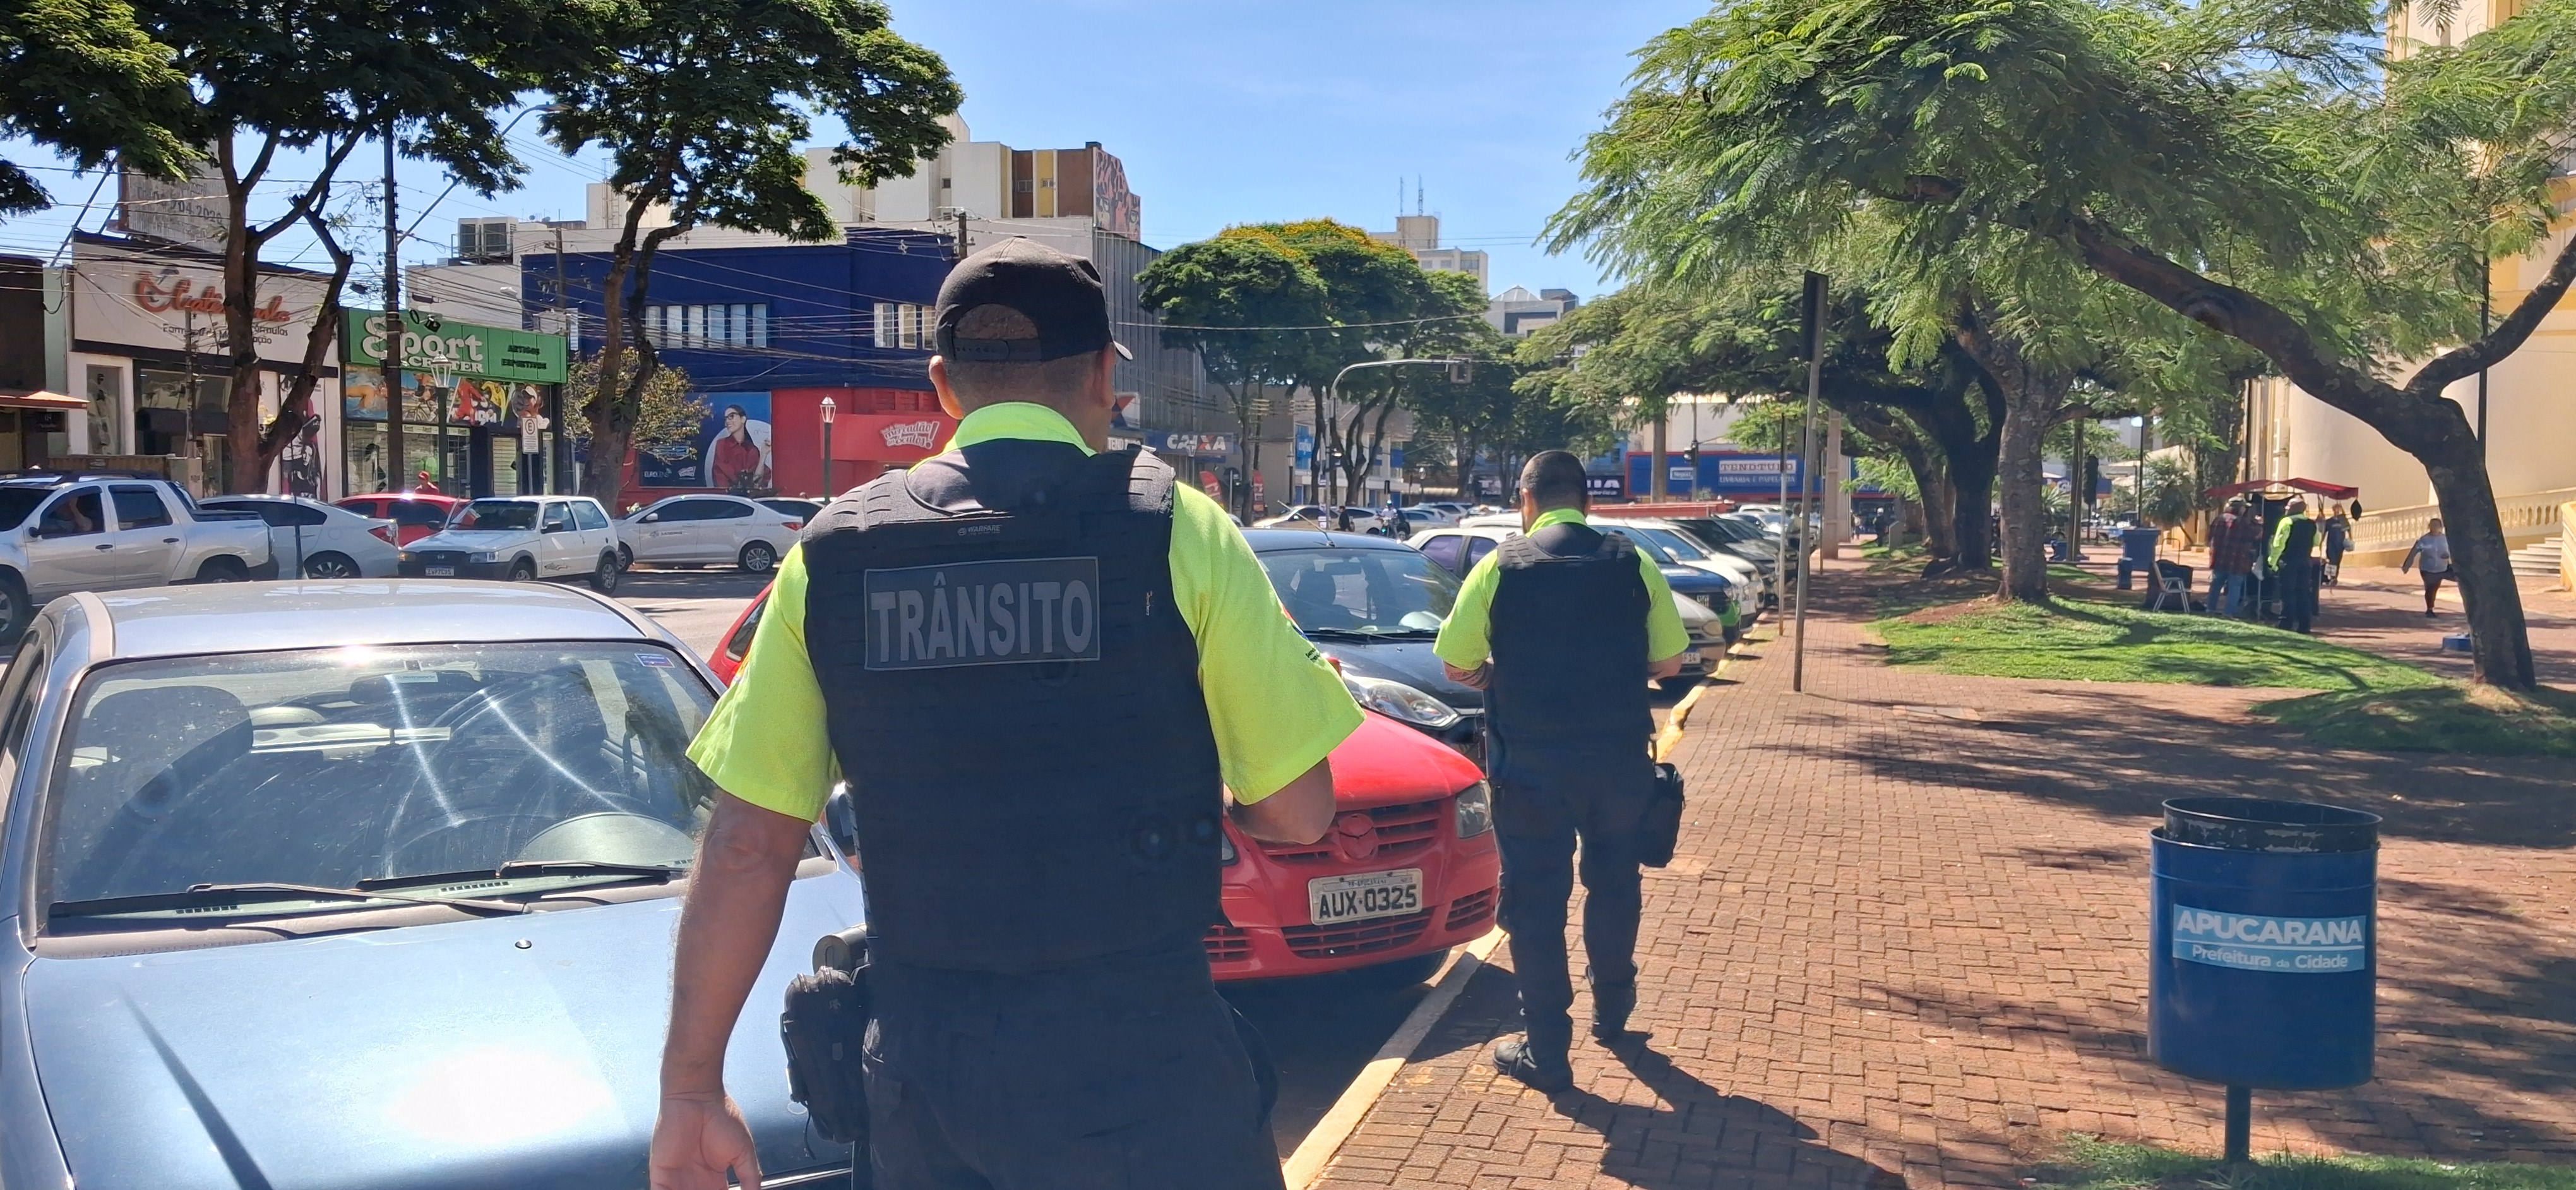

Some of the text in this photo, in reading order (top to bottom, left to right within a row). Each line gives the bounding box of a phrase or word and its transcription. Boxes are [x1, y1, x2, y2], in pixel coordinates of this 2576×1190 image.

[362, 316, 484, 362] Sport
[408, 355, 484, 374] CETER
[1167, 434, 1226, 450] CAIXA
[968, 524, 1003, 532] WARFARE
[871, 572, 1092, 662] TRÂNSITO
[2178, 910, 2363, 945] APUCARANA
[2193, 945, 2347, 968] Prefeitura da Cidade
